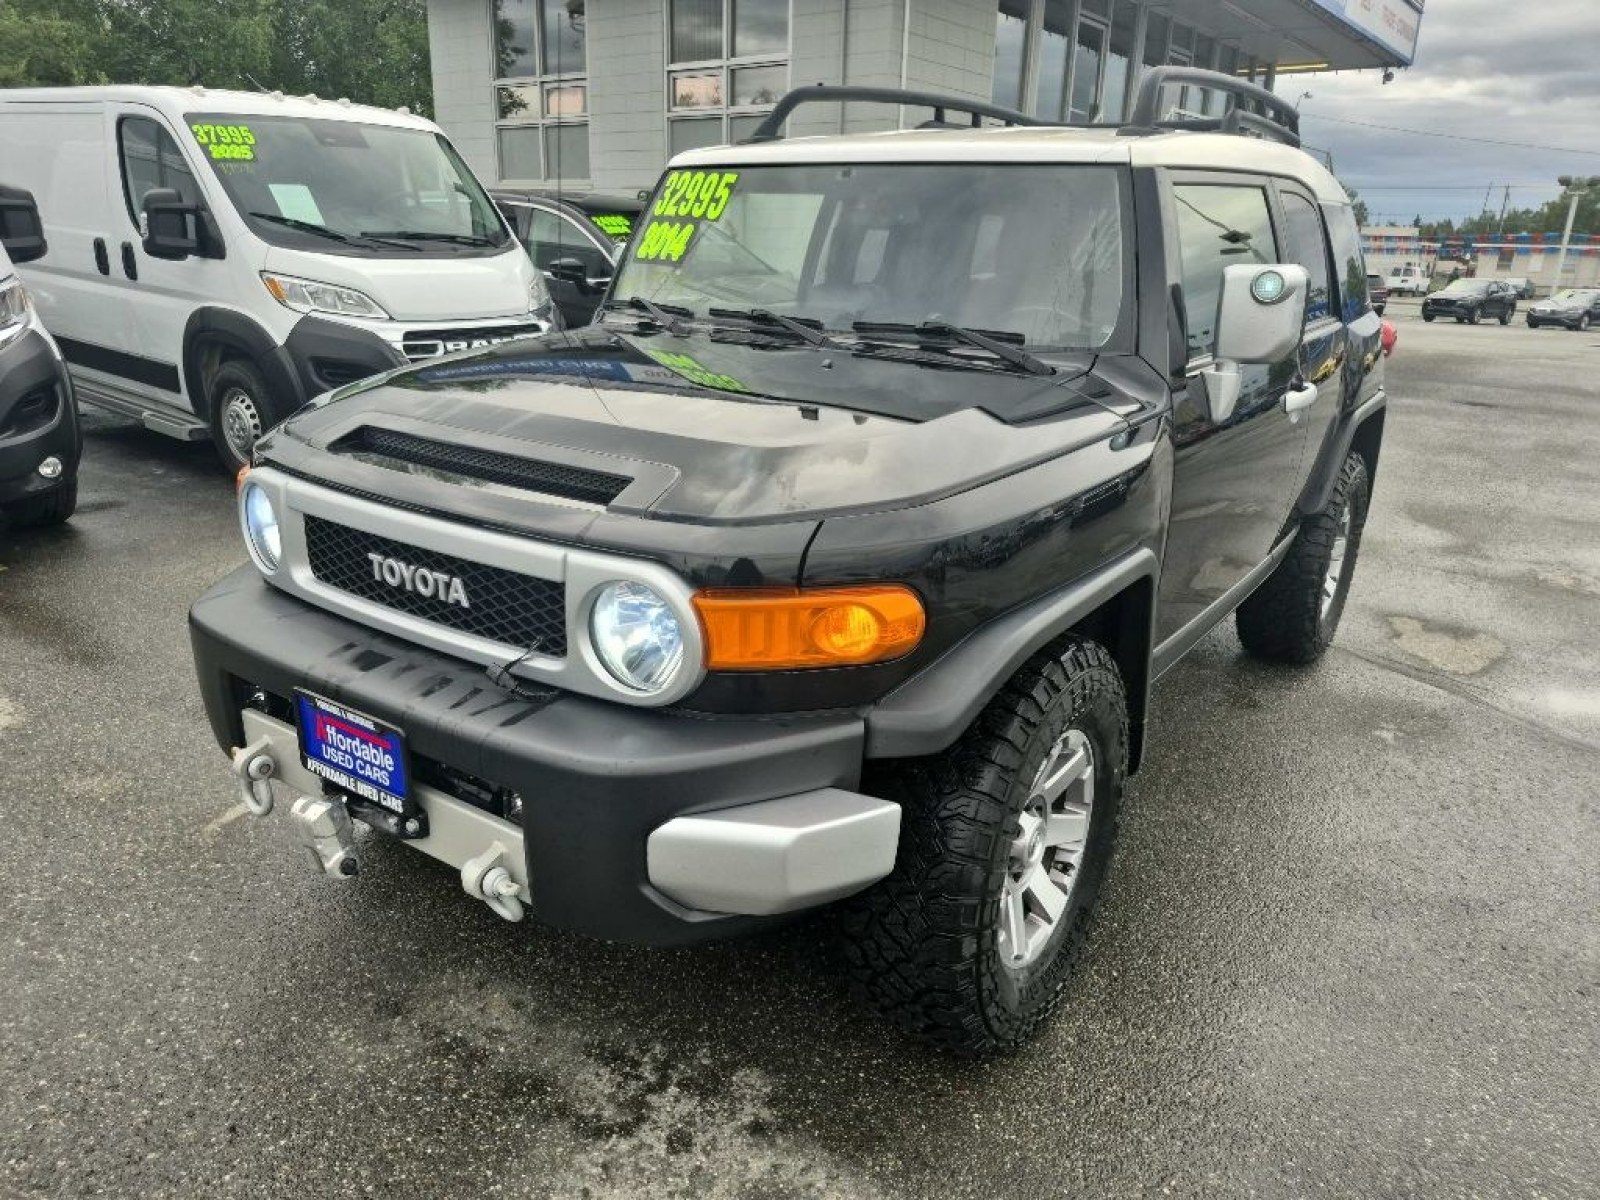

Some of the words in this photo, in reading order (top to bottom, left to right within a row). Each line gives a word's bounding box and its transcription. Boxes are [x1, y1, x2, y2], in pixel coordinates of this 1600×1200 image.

[192, 125, 255, 145] 37995
[654, 171, 738, 220] 32995
[636, 221, 695, 262] 2014
[368, 552, 470, 608] TOYOTA
[321, 743, 354, 770] USED
[355, 759, 390, 787] CARS
[356, 780, 379, 802] USED
[380, 791, 404, 813] CARS
